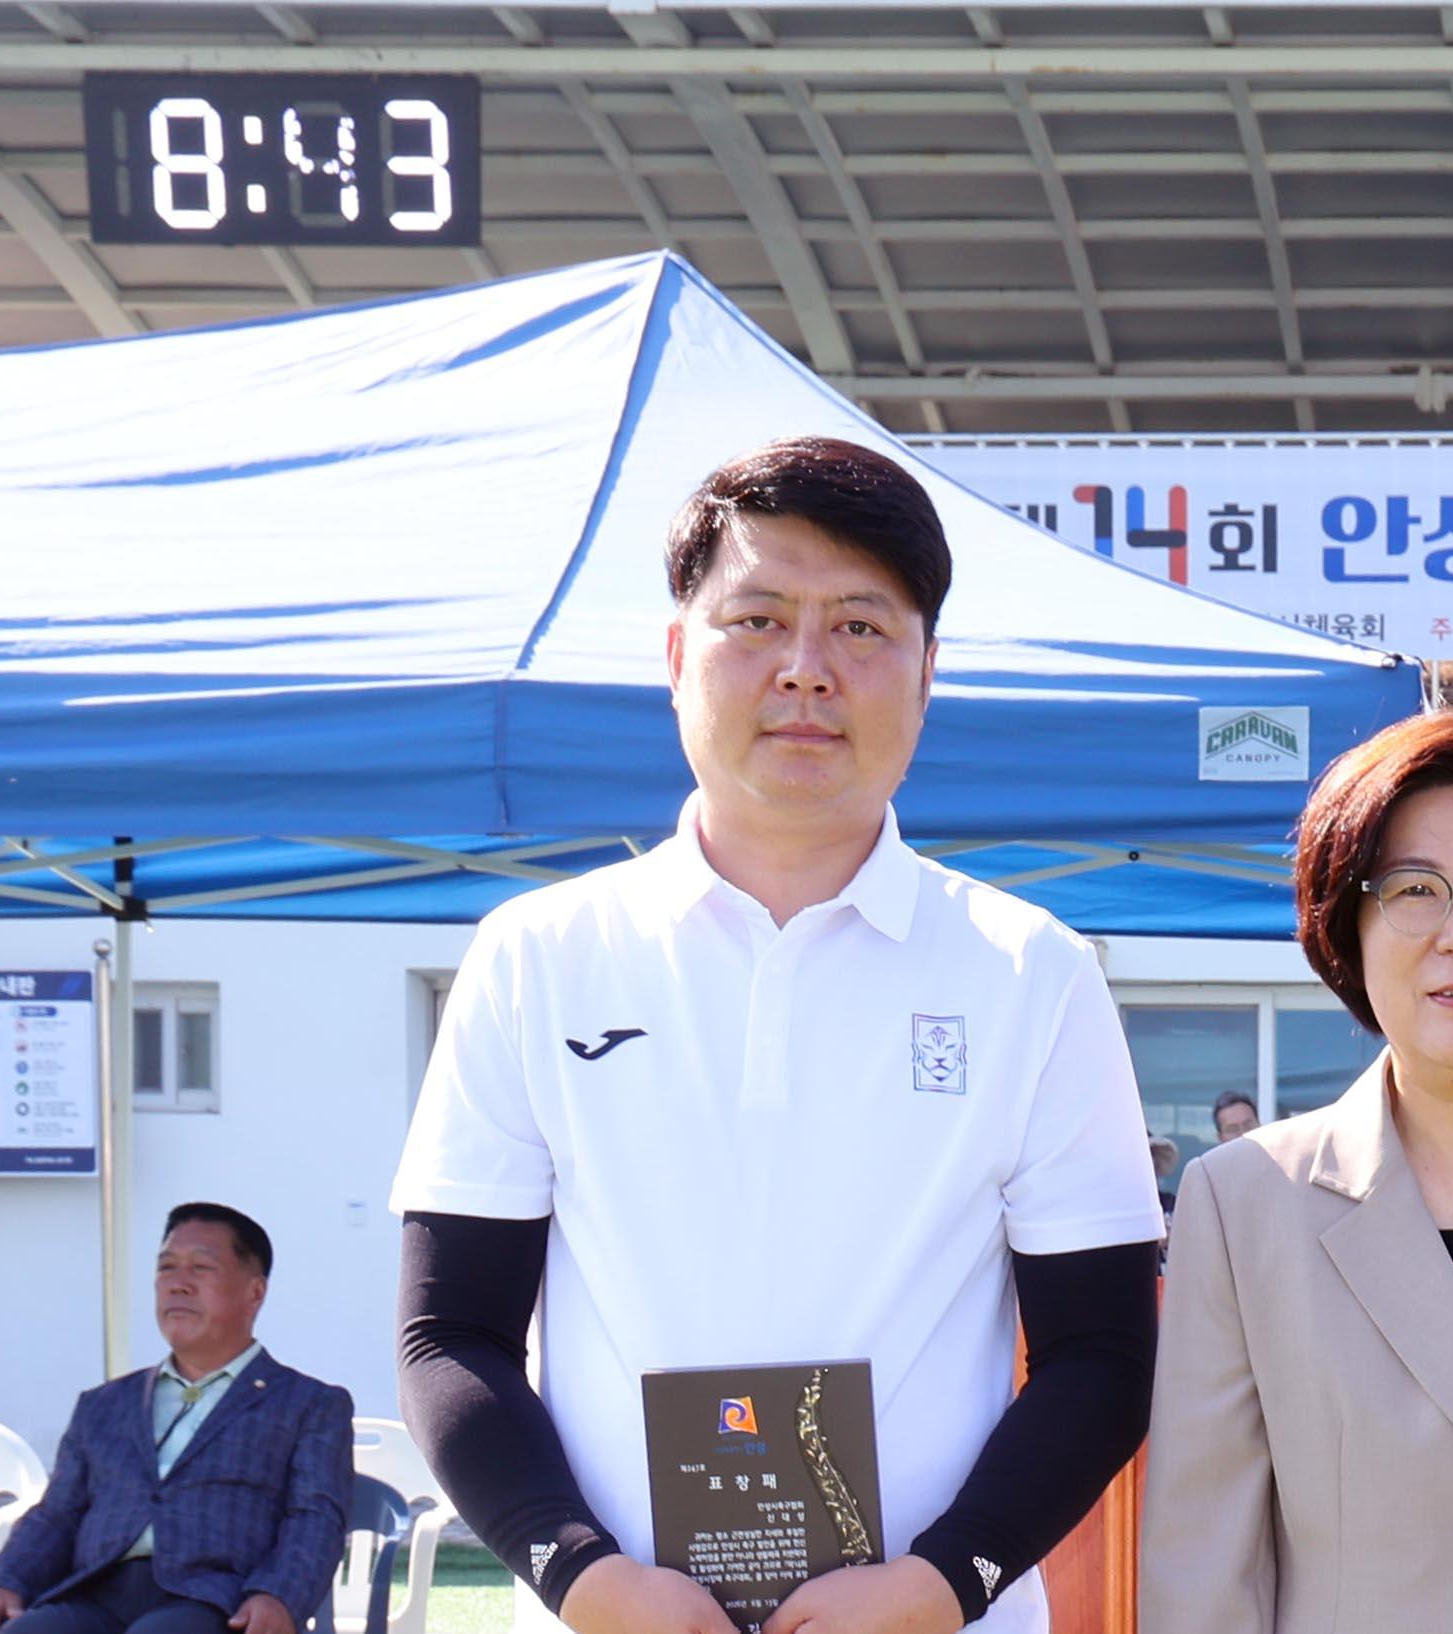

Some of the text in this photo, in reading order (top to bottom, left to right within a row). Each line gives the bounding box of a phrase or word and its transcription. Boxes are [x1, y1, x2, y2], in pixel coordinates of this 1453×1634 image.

[149, 97, 452, 231] 8:43
[1206, 716, 1298, 754] CARAVAN
[1226, 754, 1281, 762] CANOPY
